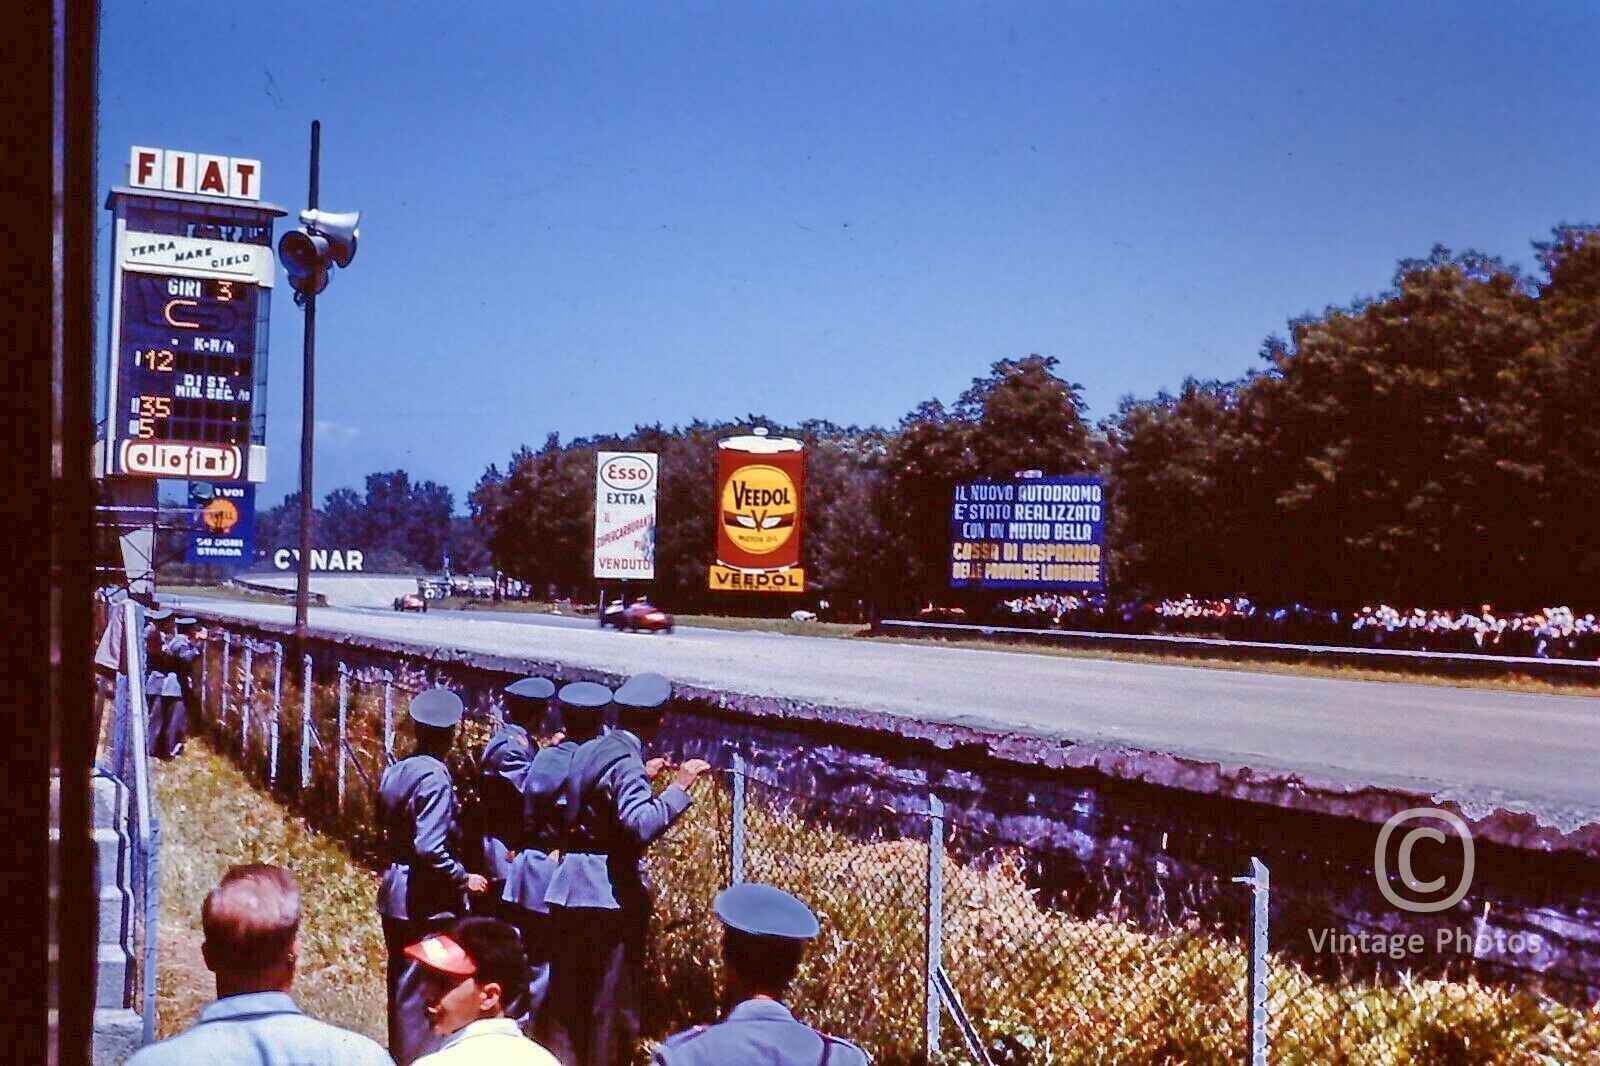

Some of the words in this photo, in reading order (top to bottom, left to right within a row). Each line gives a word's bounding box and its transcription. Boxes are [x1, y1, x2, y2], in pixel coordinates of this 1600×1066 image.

[138, 152, 254, 195] FIAT
[131, 241, 175, 256] TERRA
[175, 248, 212, 261] MARE
[211, 254, 250, 268] CIELO
[168, 279, 201, 297] GIRI
[217, 281, 232, 301] 3
[145, 350, 173, 371] 12
[140, 395, 171, 418] 35
[139, 418, 154, 438] 5
[136, 445, 227, 471] oliofiat
[607, 493, 645, 505] EXTRA
[732, 480, 791, 510] VEEDOL
[955, 486, 968, 501] IL
[970, 484, 1014, 501] NUOVO
[1018, 485, 1101, 502] AUTODROMO
[969, 504, 1011, 520] STATO
[1014, 504, 1100, 521] REALIZZATO
[963, 522, 984, 539] CON
[990, 523, 1005, 539] UN
[1009, 522, 1051, 540] MUTUO
[1054, 523, 1092, 541] DELLA
[196, 547, 242, 557] STRADA
[1003, 543, 1018, 561] DI
[1022, 543, 1100, 562] RISPARMIO
[599, 559, 651, 570] VENDUTO
[716, 572, 799, 587] VEEDOL
